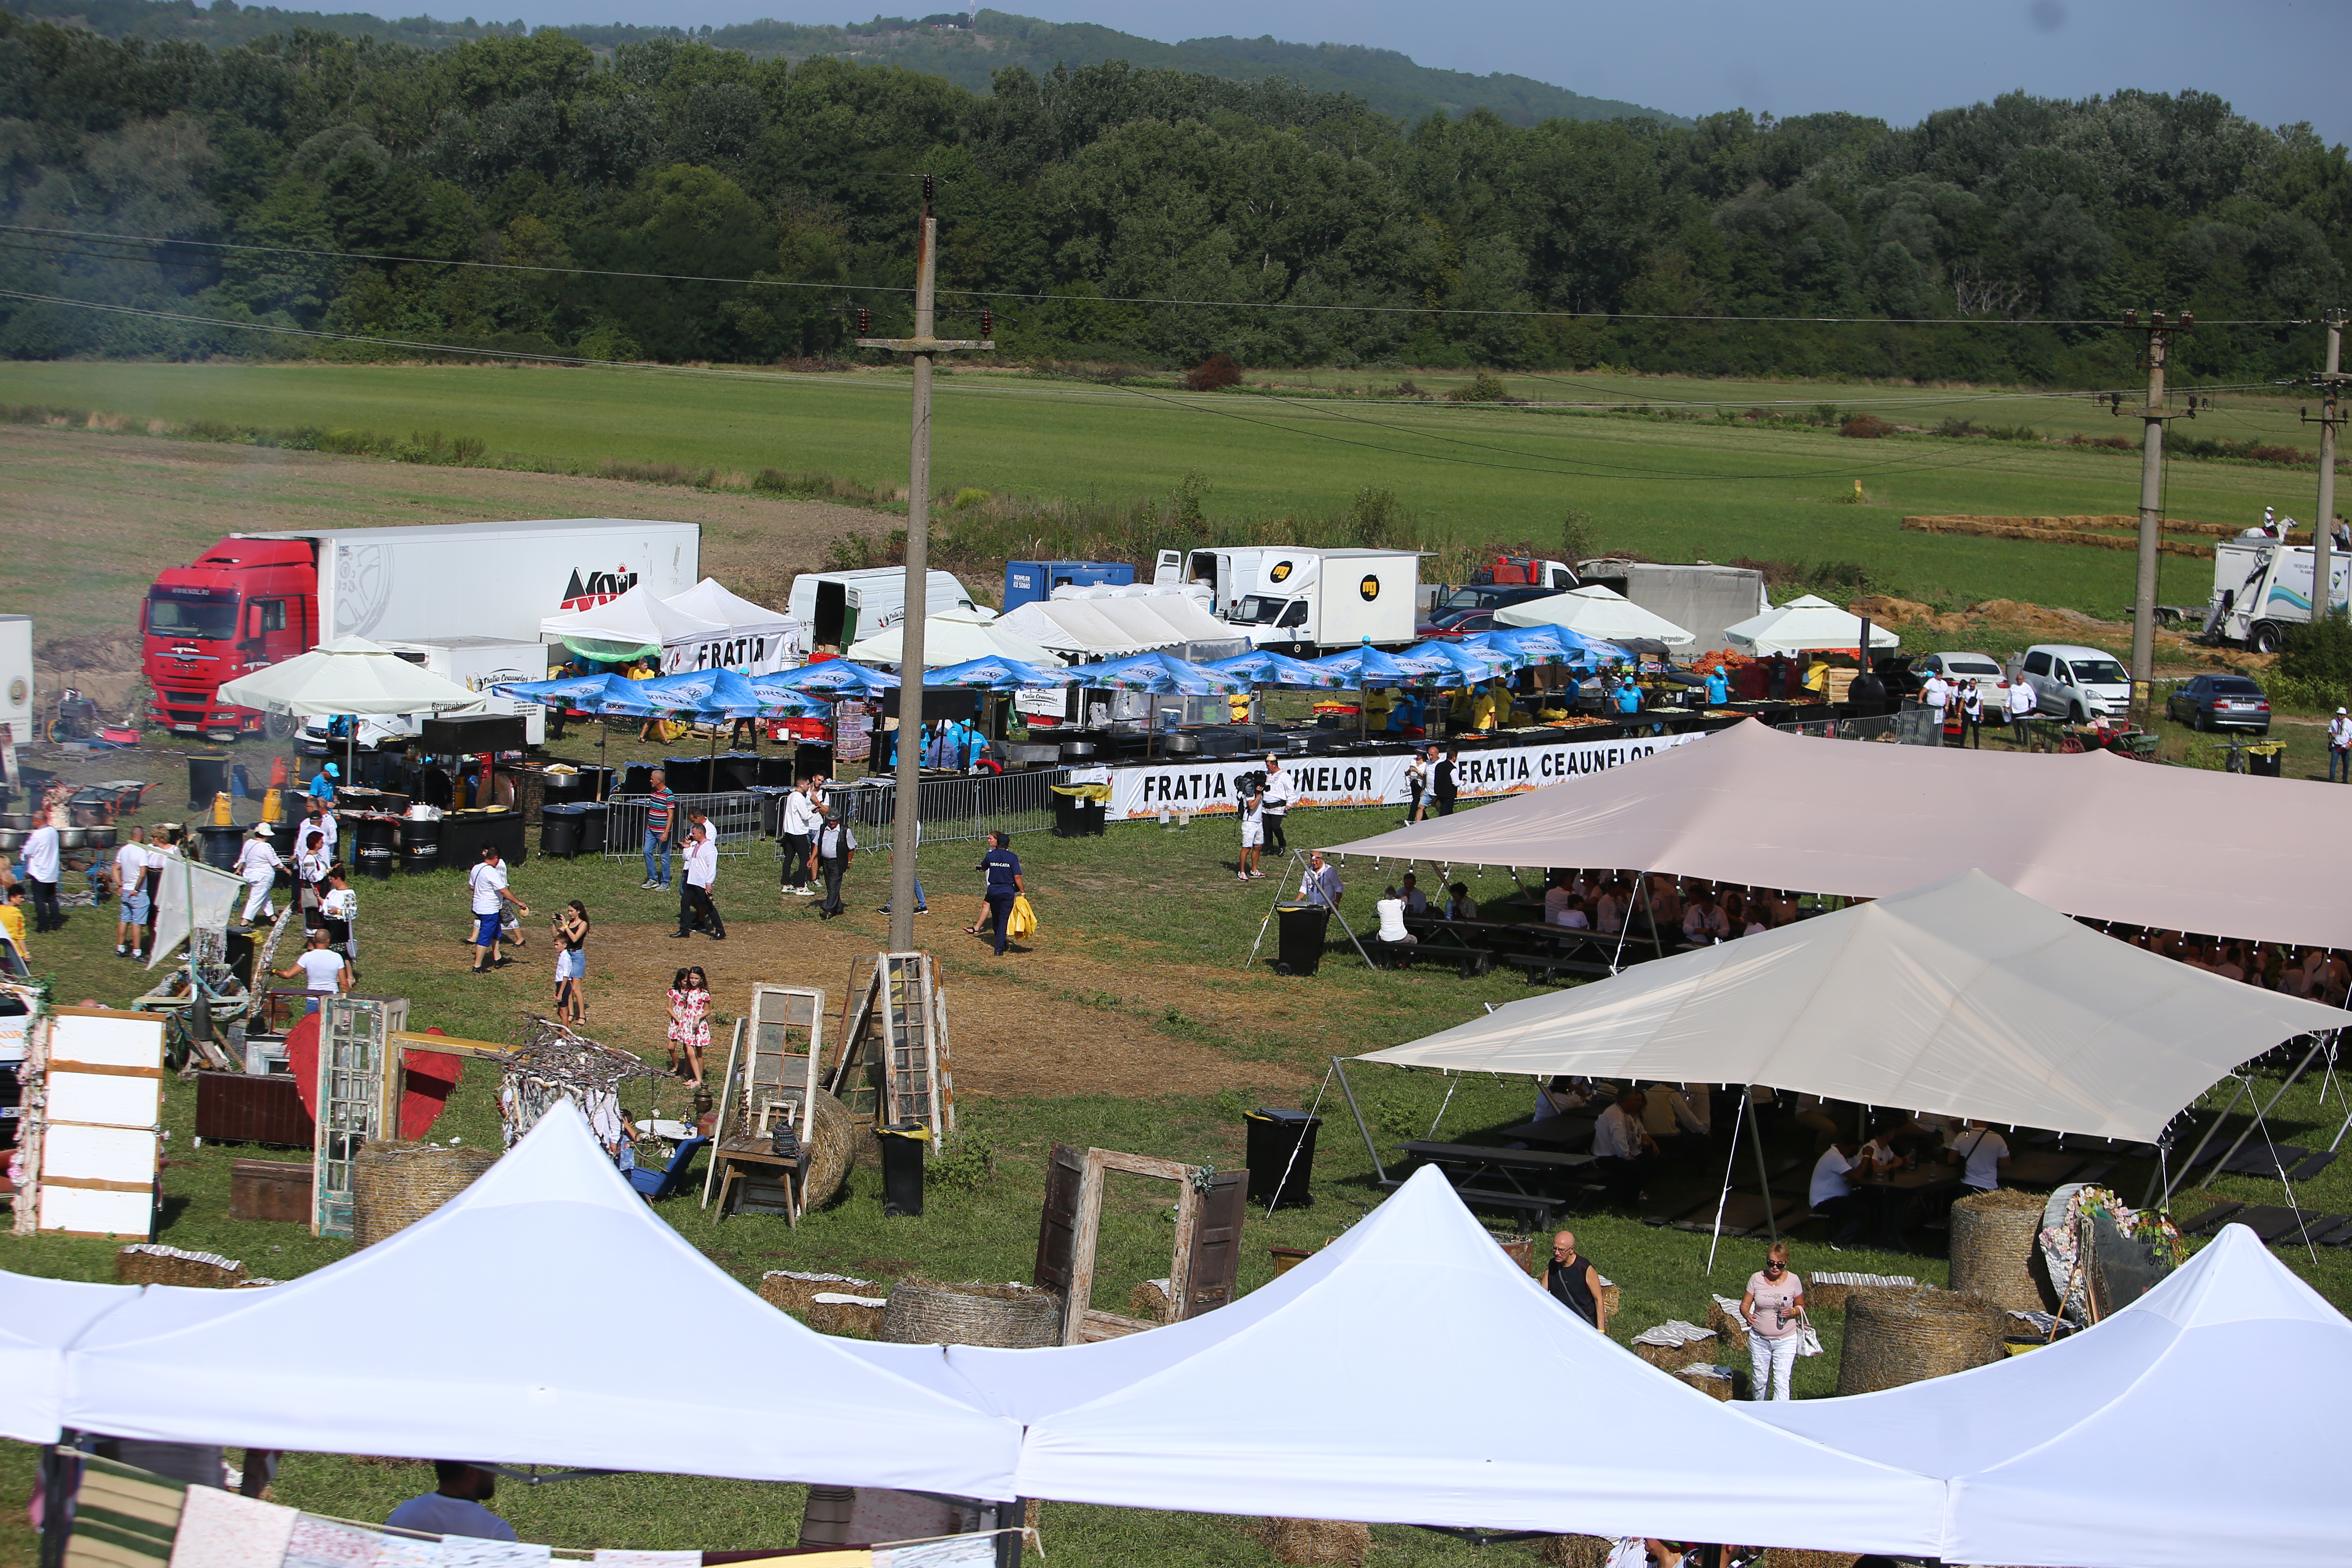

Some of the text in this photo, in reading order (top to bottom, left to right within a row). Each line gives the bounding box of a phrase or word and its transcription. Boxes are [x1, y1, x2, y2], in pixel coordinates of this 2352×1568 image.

[1362, 581, 1376, 596] mg
[1660, 635, 1685, 643] Bergenbier
[698, 637, 764, 670] FRATIA
[1585, 643, 1620, 655] BORSEC
[1395, 662, 1436, 671] BORSEC
[646, 694, 696, 707] BORSEC
[753, 689, 803, 703] BORSEC
[1458, 756, 1529, 784] FRATIA
[1143, 773, 1227, 802] FRATIA
[2138, 1234, 2156, 1244] THIS IS
